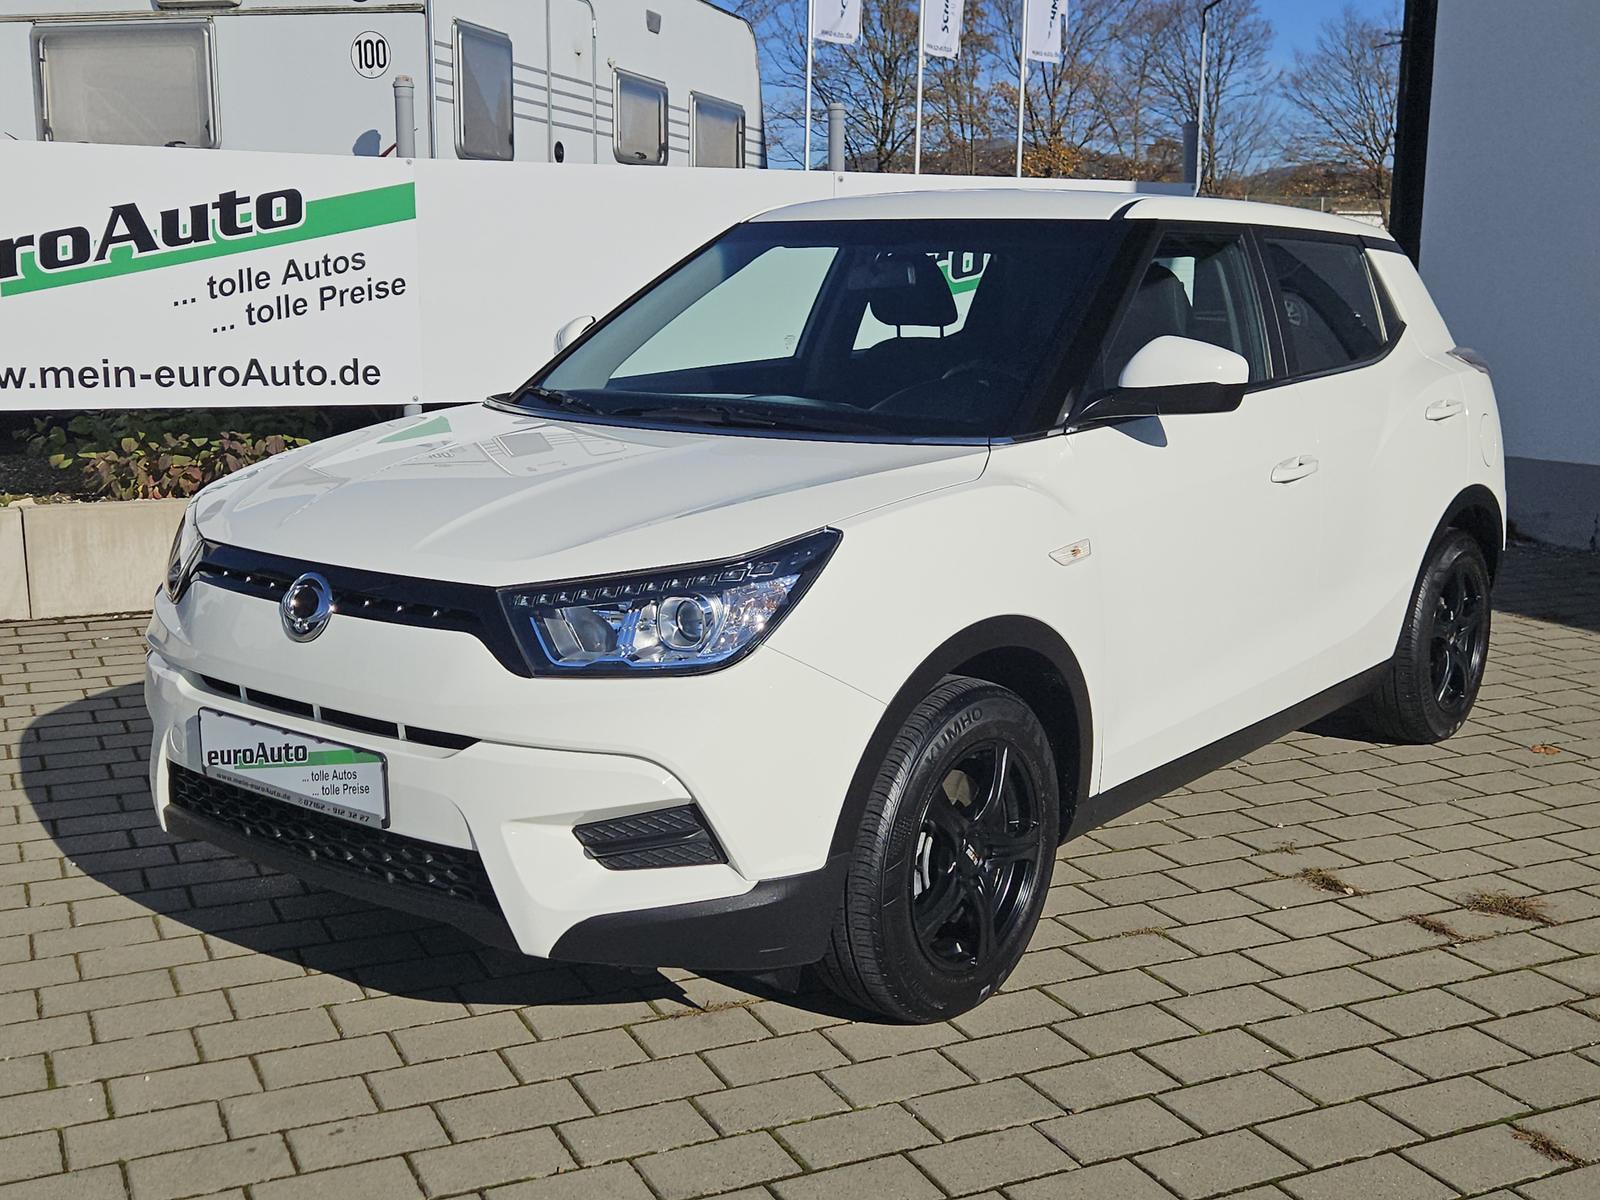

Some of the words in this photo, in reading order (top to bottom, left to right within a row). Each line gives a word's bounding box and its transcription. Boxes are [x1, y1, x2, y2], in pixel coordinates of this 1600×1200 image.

[355, 39, 387, 69] 100
[207, 267, 271, 299] tolle
[281, 252, 367, 286] Autos
[245, 294, 308, 326] tolle
[319, 277, 407, 311] Preise
[0, 357, 382, 389] w.mein-euroAuto.de
[207, 742, 308, 766] euroAuto
[311, 770, 330, 782] tolle
[331, 769, 358, 781] Autos
[321, 784, 341, 796] tolle
[342, 783, 370, 795] Preise
